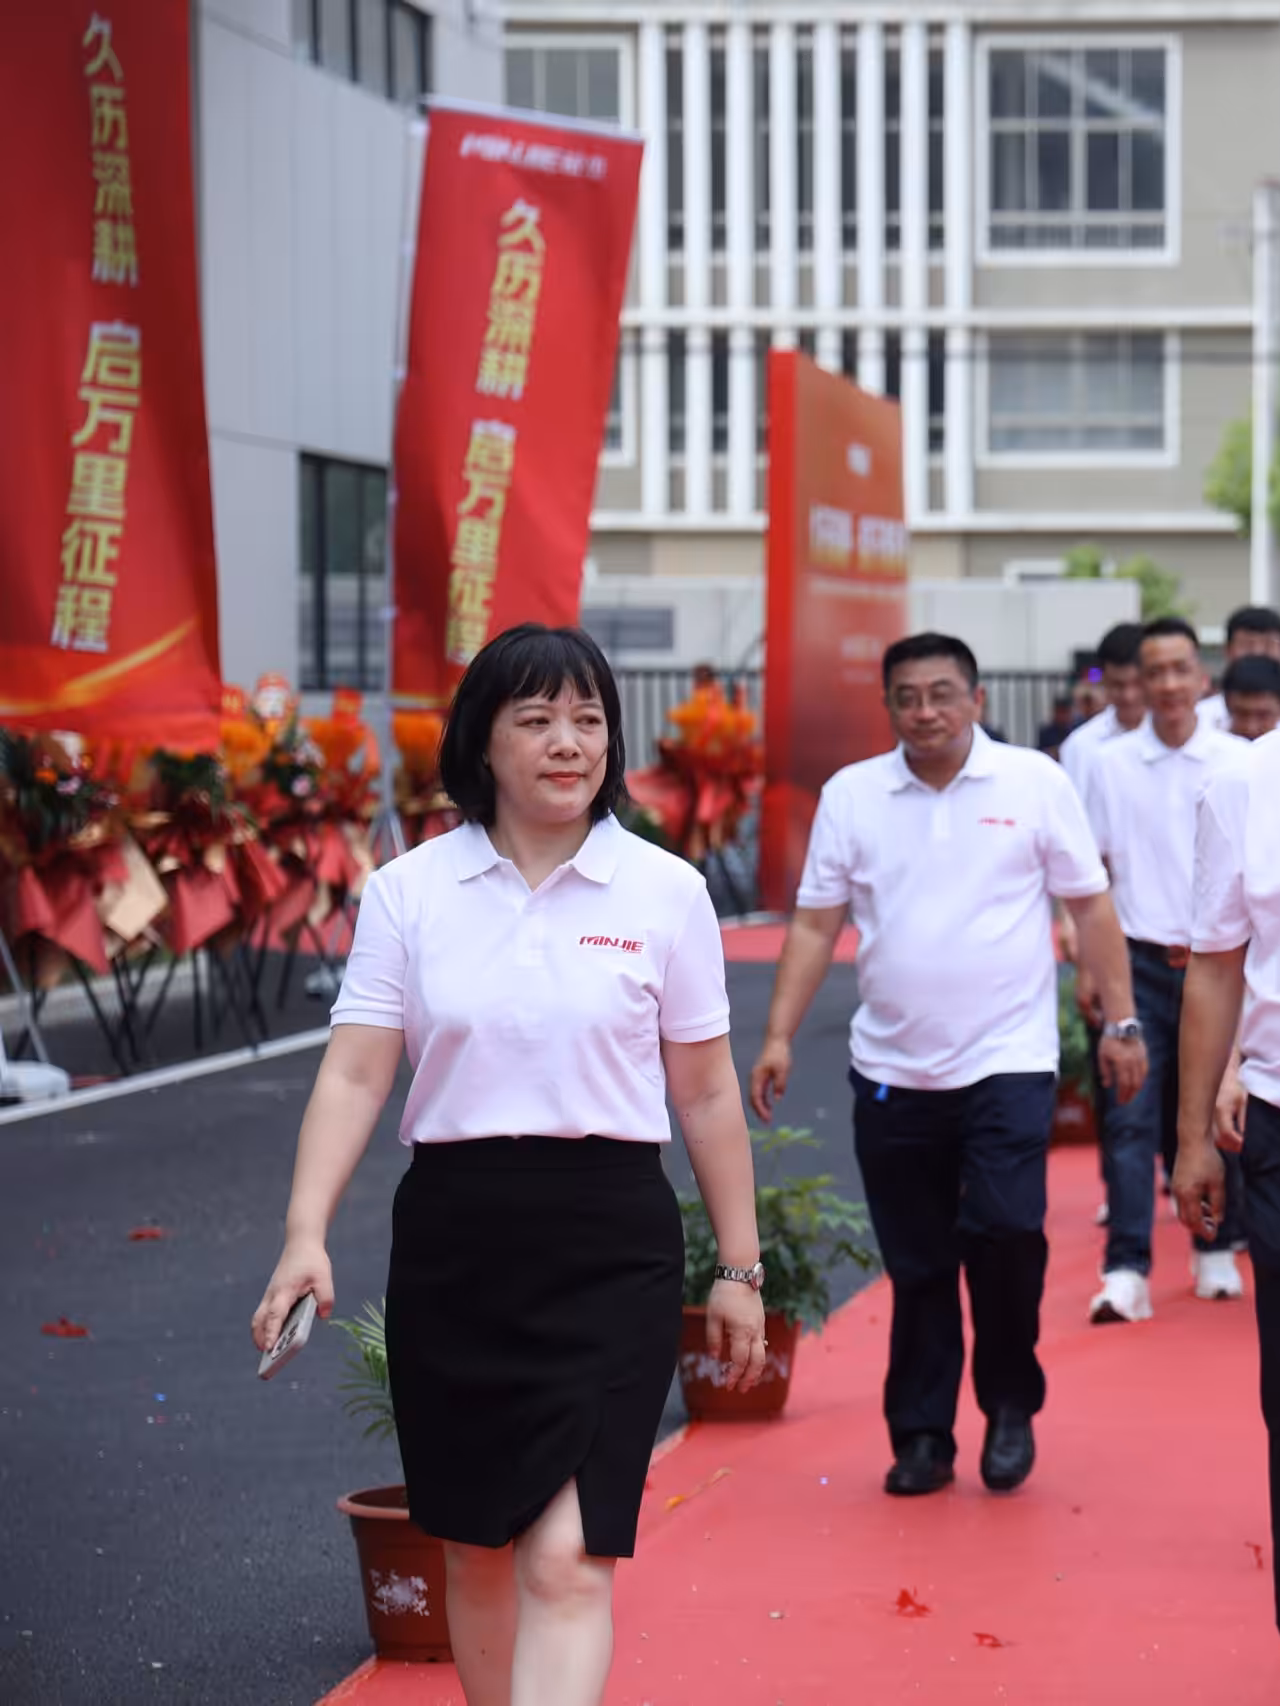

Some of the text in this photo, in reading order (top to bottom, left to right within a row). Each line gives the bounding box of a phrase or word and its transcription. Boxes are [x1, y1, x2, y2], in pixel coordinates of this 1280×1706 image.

[51, 12, 141, 652] 久历深耕 启万里征程
[579, 935, 644, 951] MINJIE
